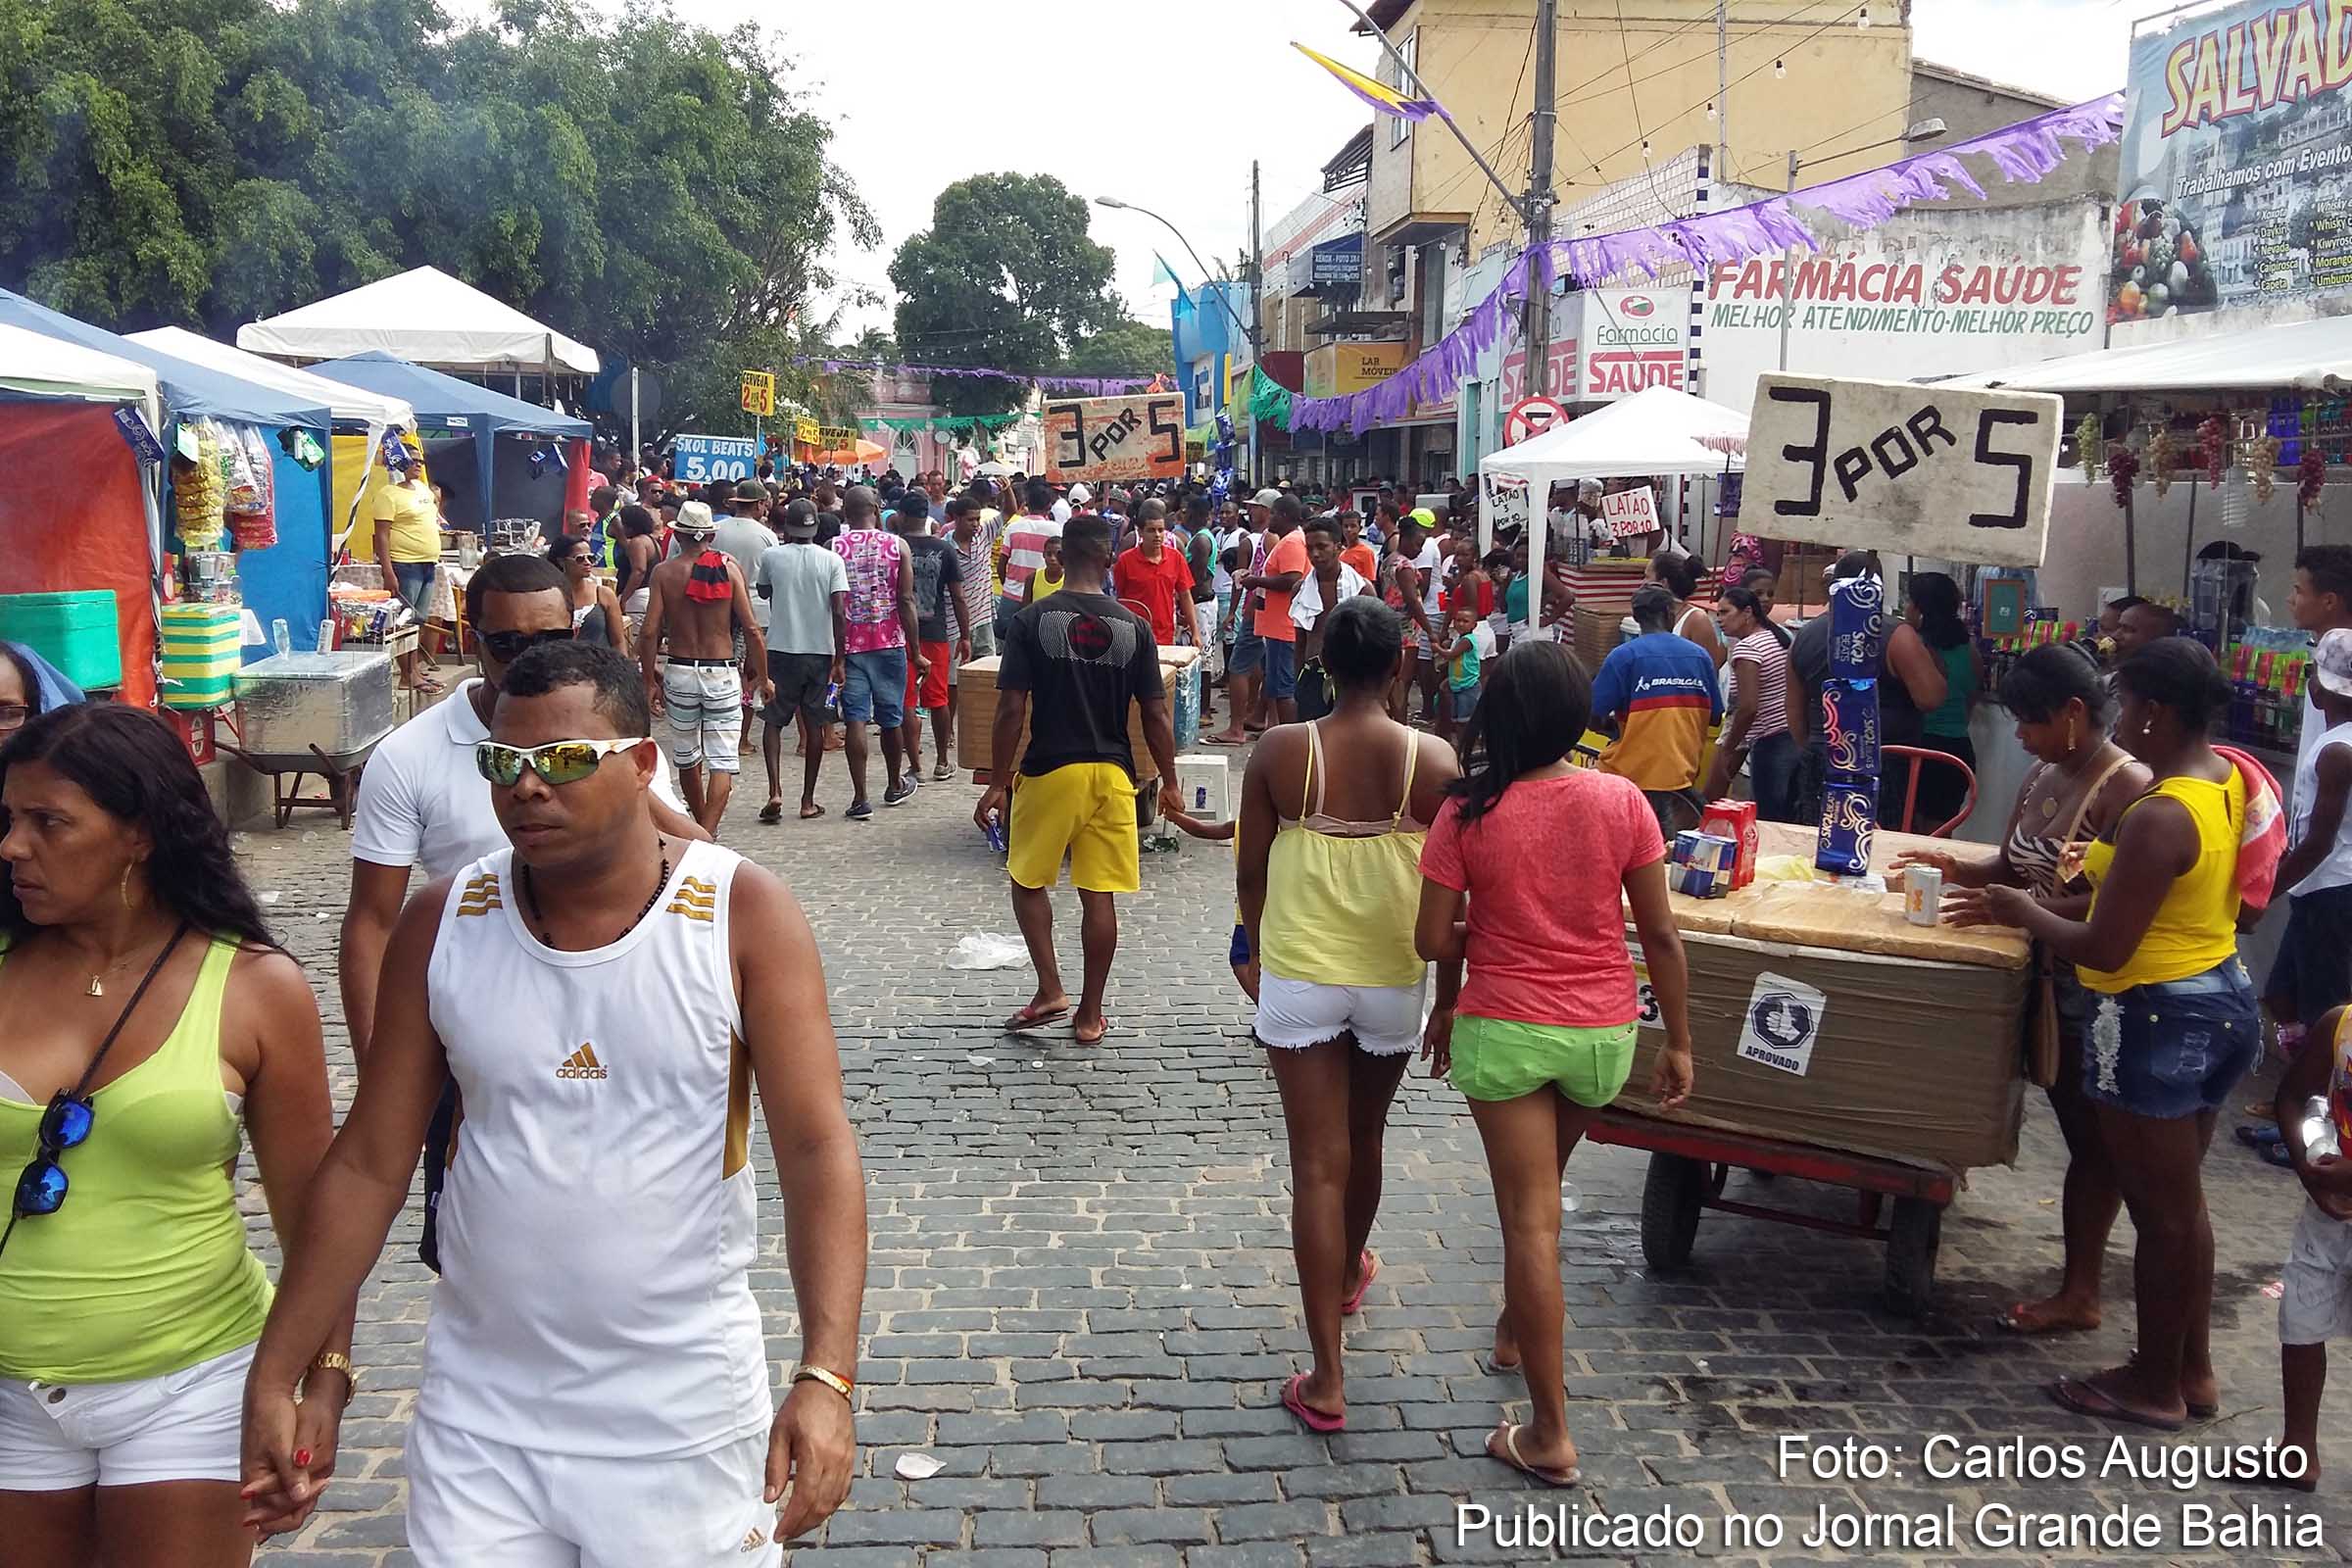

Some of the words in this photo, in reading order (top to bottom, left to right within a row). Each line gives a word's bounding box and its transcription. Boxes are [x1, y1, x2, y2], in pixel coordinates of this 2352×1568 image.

[2178, 165, 2263, 199] Trabalhamos
[2265, 157, 2296, 178] com
[2298, 143, 2352, 172] Evento
[2316, 219, 2346, 232] Whisky
[2261, 241, 2290, 256] Nevada
[2260, 259, 2299, 274] Caipirosca
[1708, 251, 1924, 303] FARMÁCIA
[1936, 255, 2082, 306] SAÚDE
[2261, 278, 2288, 292] Capeta
[1597, 322, 1679, 344] Farmácia
[2030, 311, 2094, 338] PREÇO
[1361, 357, 1380, 367] LAR
[743, 386, 751, 409] 2
[760, 388, 768, 413] 5
[818, 427, 850, 438] RVEJA
[1049, 403, 1087, 468] 3
[1089, 407, 1143, 463] POR
[1148, 400, 1181, 464] 5
[676, 437, 708, 454] SKOL
[711, 439, 755, 458] BEATS
[1769, 386, 1831, 516] 3
[1834, 405, 1957, 503] POR
[1968, 409, 2038, 529] 5
[686, 457, 746, 482] 5.00
[1620, 520, 1640, 535] POR
[1840, 633, 1851, 662] BEATS
[1851, 631, 1866, 666] SKOL
[1744, 1045, 1800, 1071] APROVADO
[556, 1064, 609, 1080] adidas
